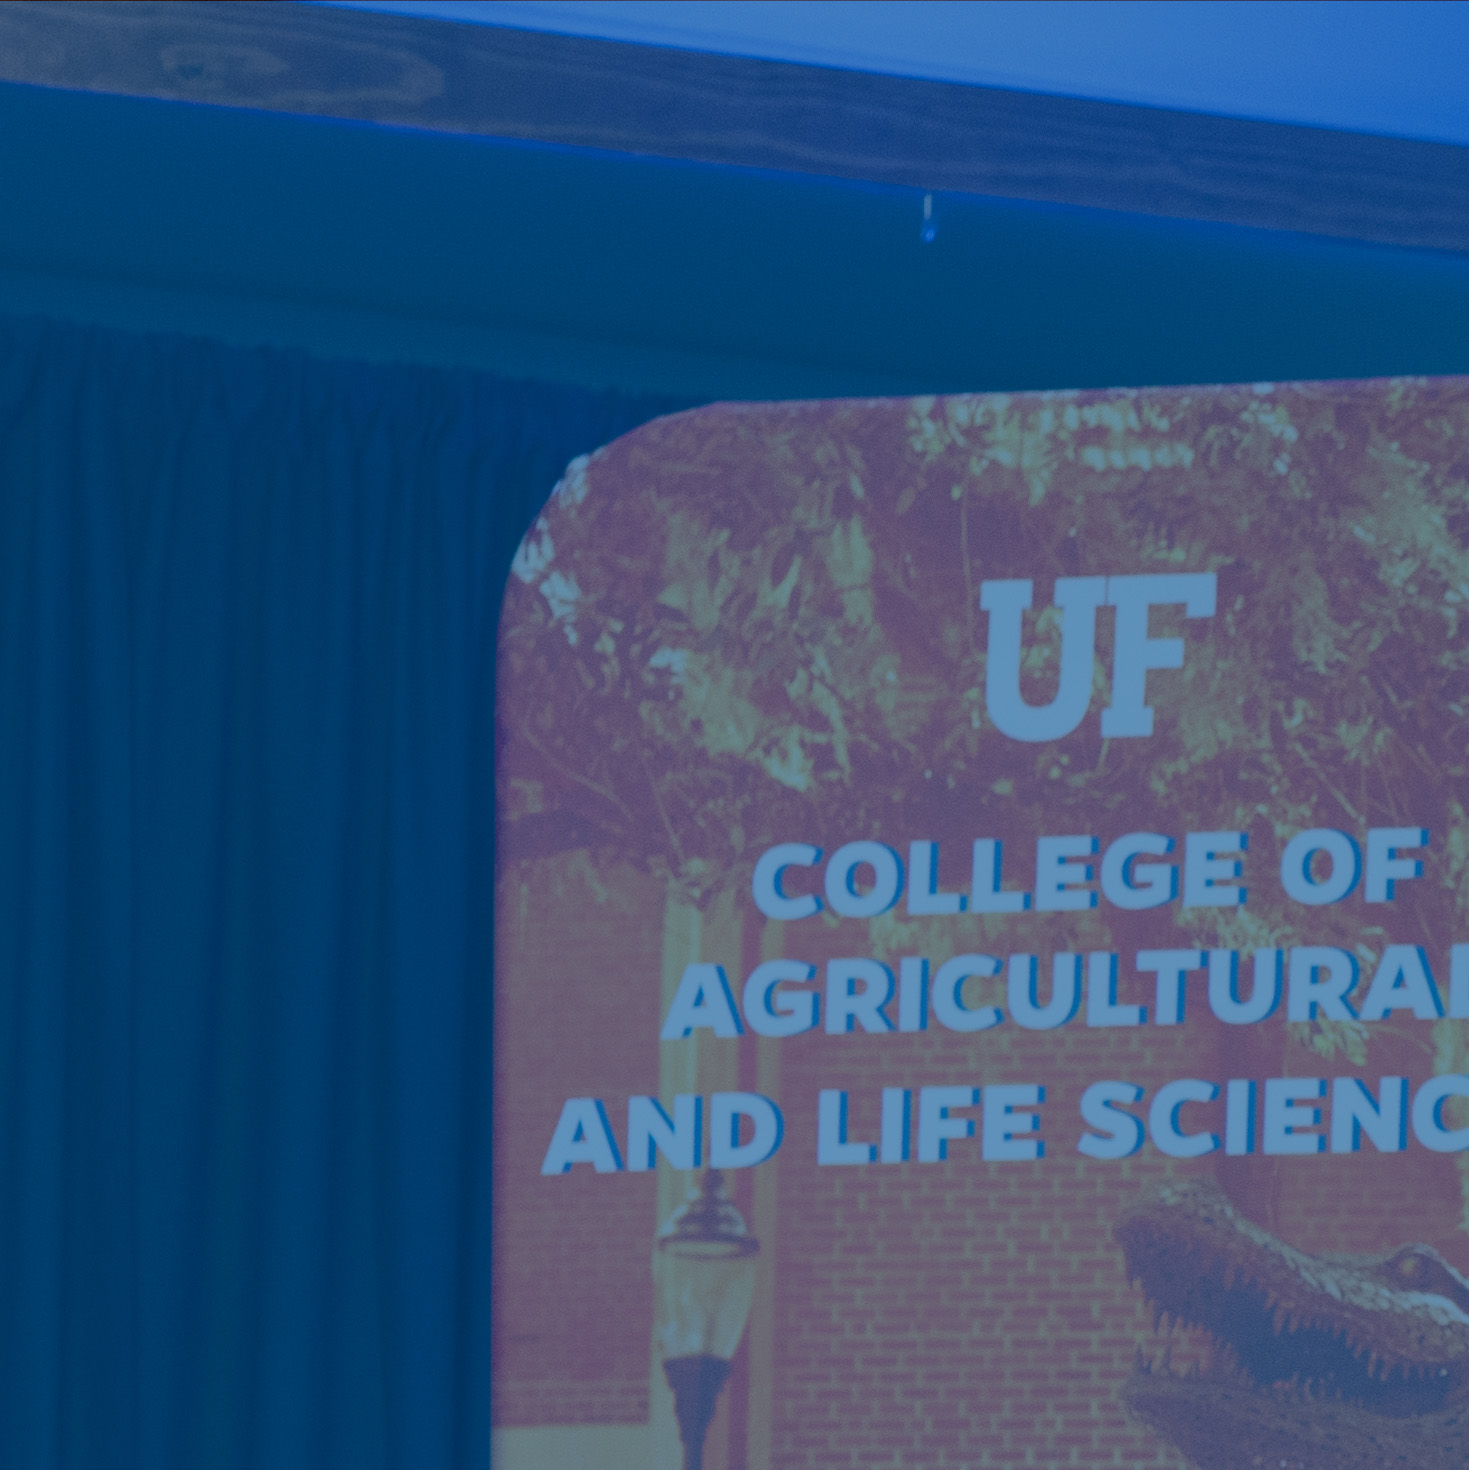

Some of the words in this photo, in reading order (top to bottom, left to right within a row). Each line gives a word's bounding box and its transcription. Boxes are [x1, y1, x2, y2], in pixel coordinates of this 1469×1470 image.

[980, 573, 1217, 741] UF
[752, 831, 1248, 919] COLLEGE
[1281, 827, 1428, 904] OF
[542, 1092, 784, 1175] AND
[817, 1085, 1045, 1165] LIFE
